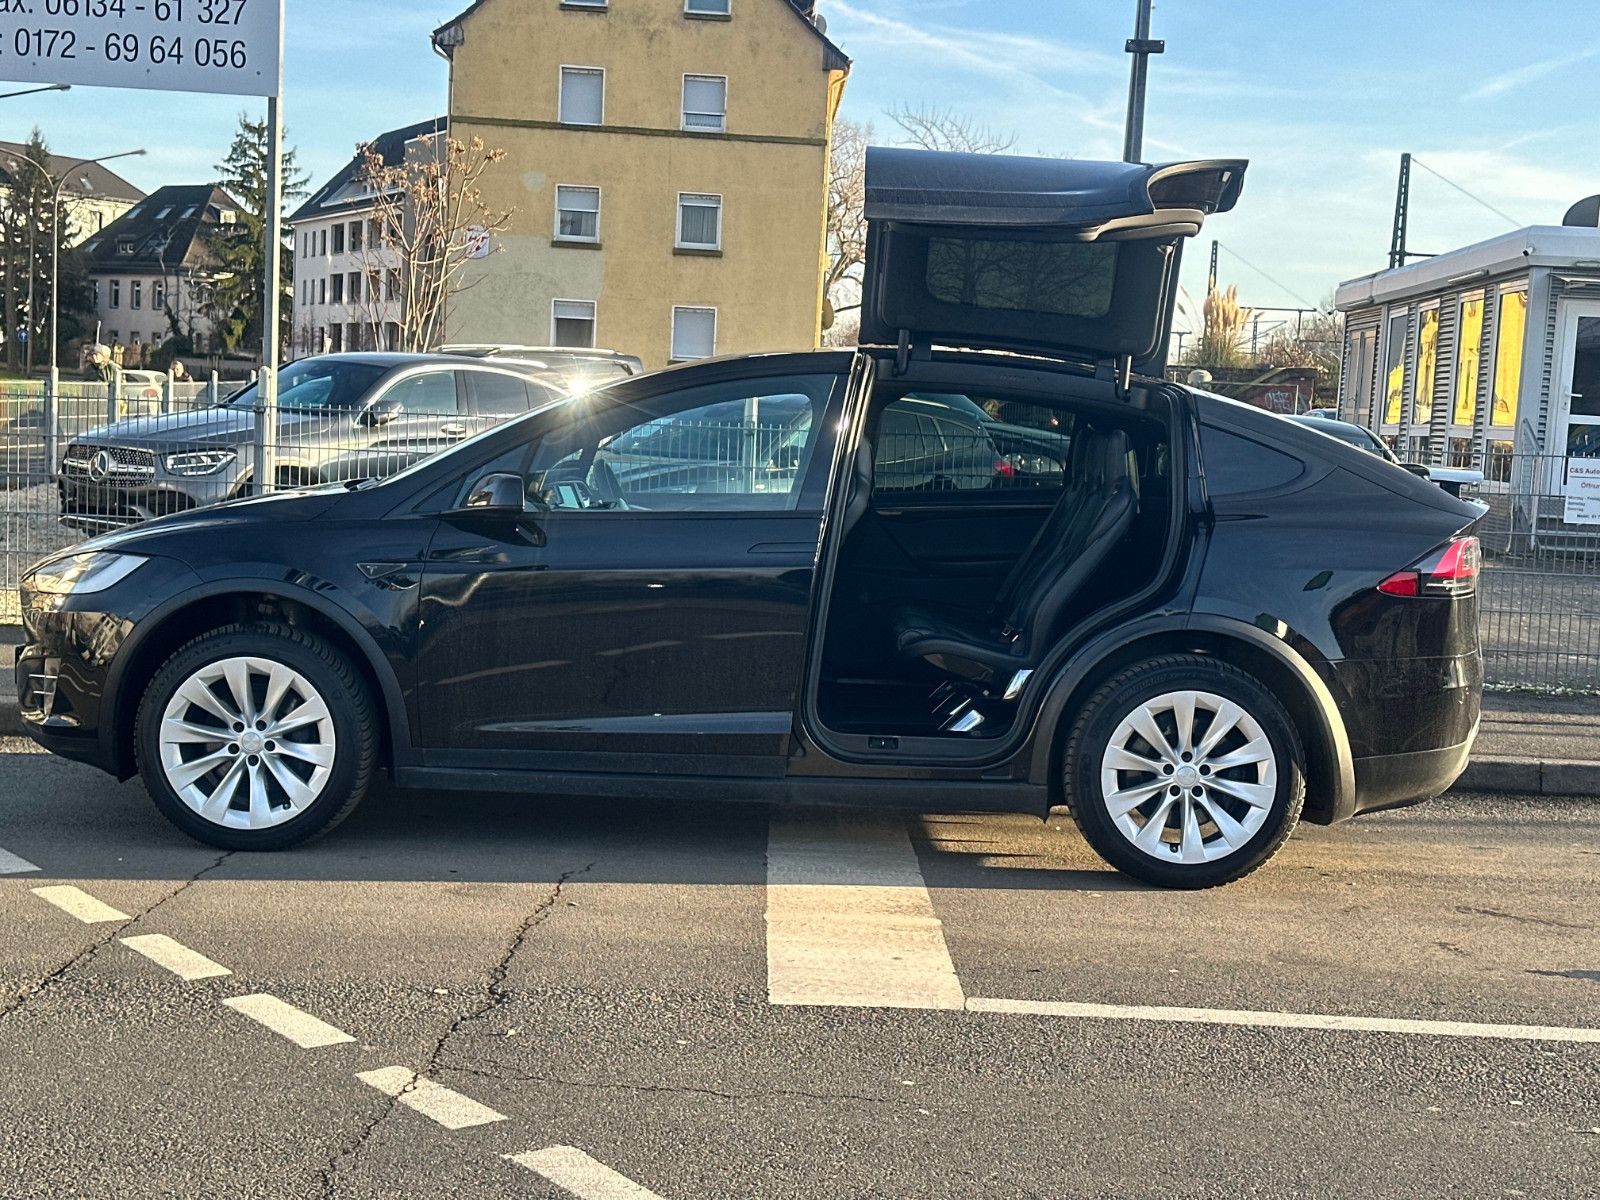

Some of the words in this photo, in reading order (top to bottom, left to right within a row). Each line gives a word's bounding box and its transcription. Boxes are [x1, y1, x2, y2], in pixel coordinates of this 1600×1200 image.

[45, 0, 126, 18] 06134
[155, 0, 182, 21] 61
[197, 0, 247, 25] 327
[14, 28, 76, 59] 0172
[105, 32, 139, 62] 69
[149, 35, 184, 65] 64
[194, 38, 247, 69] 056
